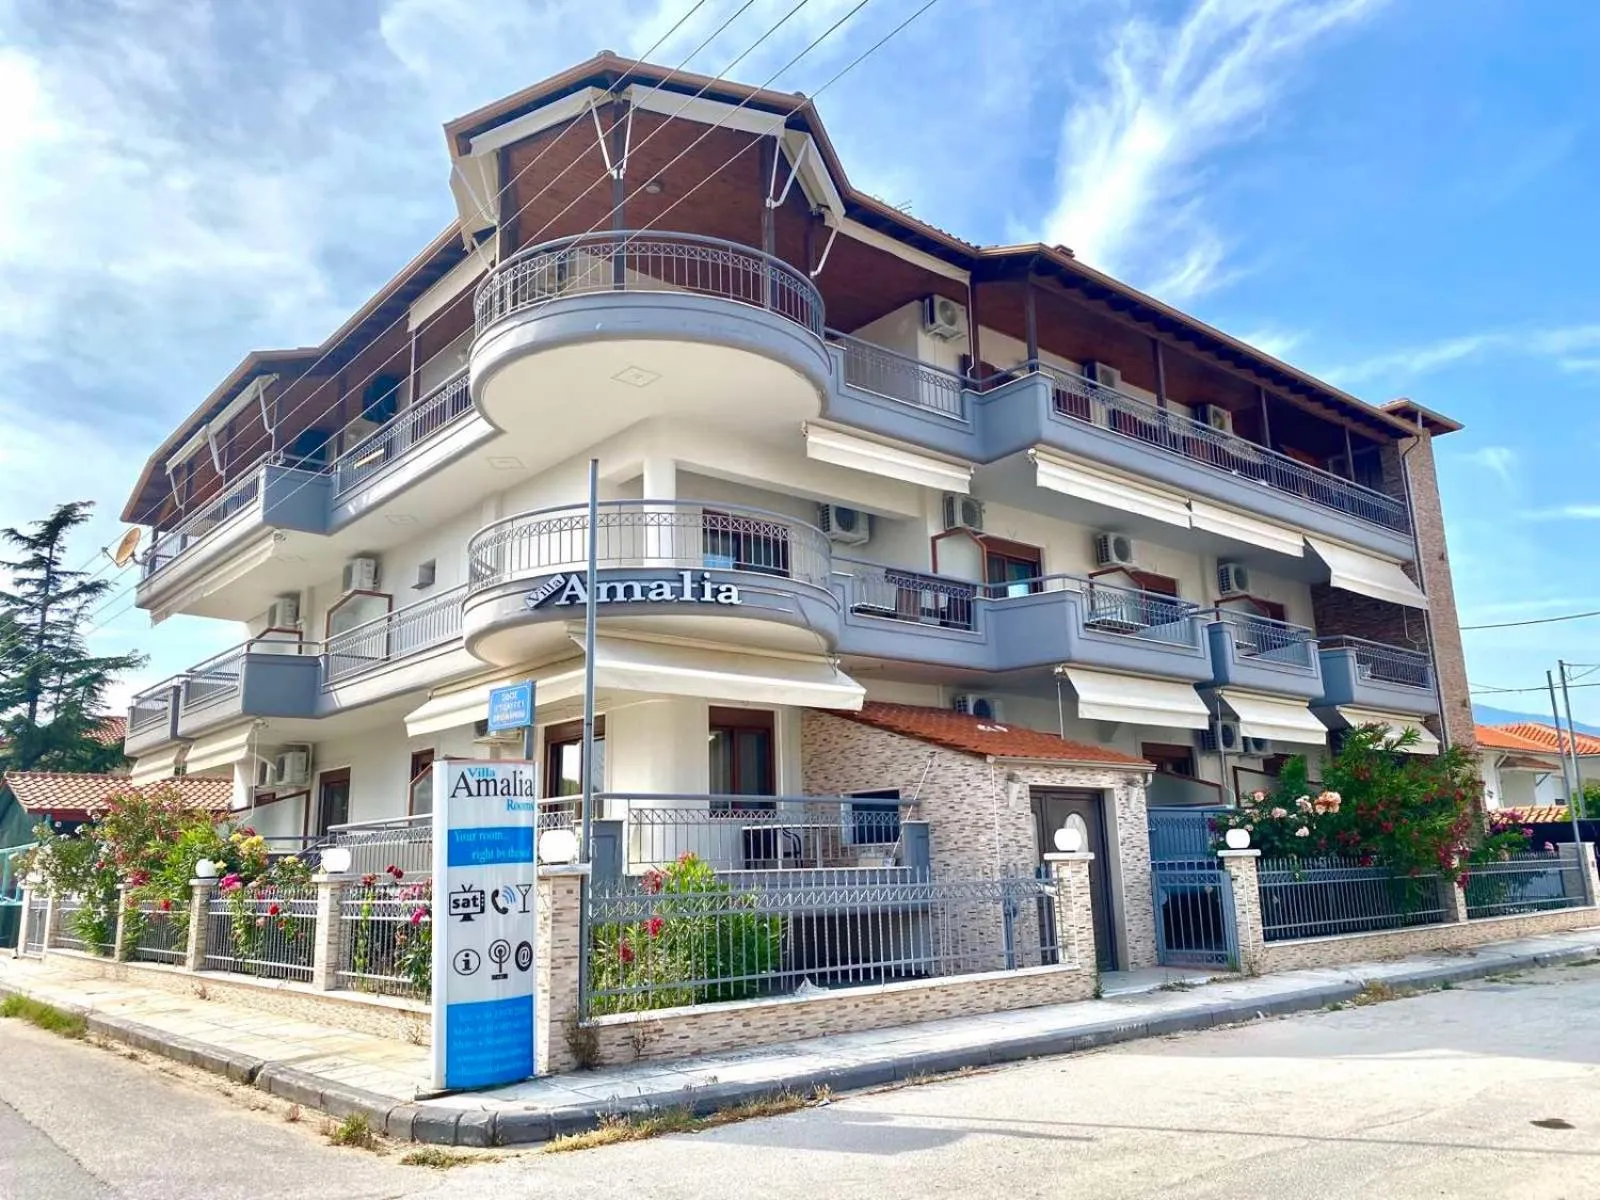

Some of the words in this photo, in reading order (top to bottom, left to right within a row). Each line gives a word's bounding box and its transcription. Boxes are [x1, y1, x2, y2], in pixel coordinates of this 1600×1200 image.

[527, 576, 564, 606] Villa
[555, 571, 742, 605] Amalia
[467, 767, 496, 778] Villa
[450, 770, 534, 798] Amalia
[452, 895, 480, 909] sat
